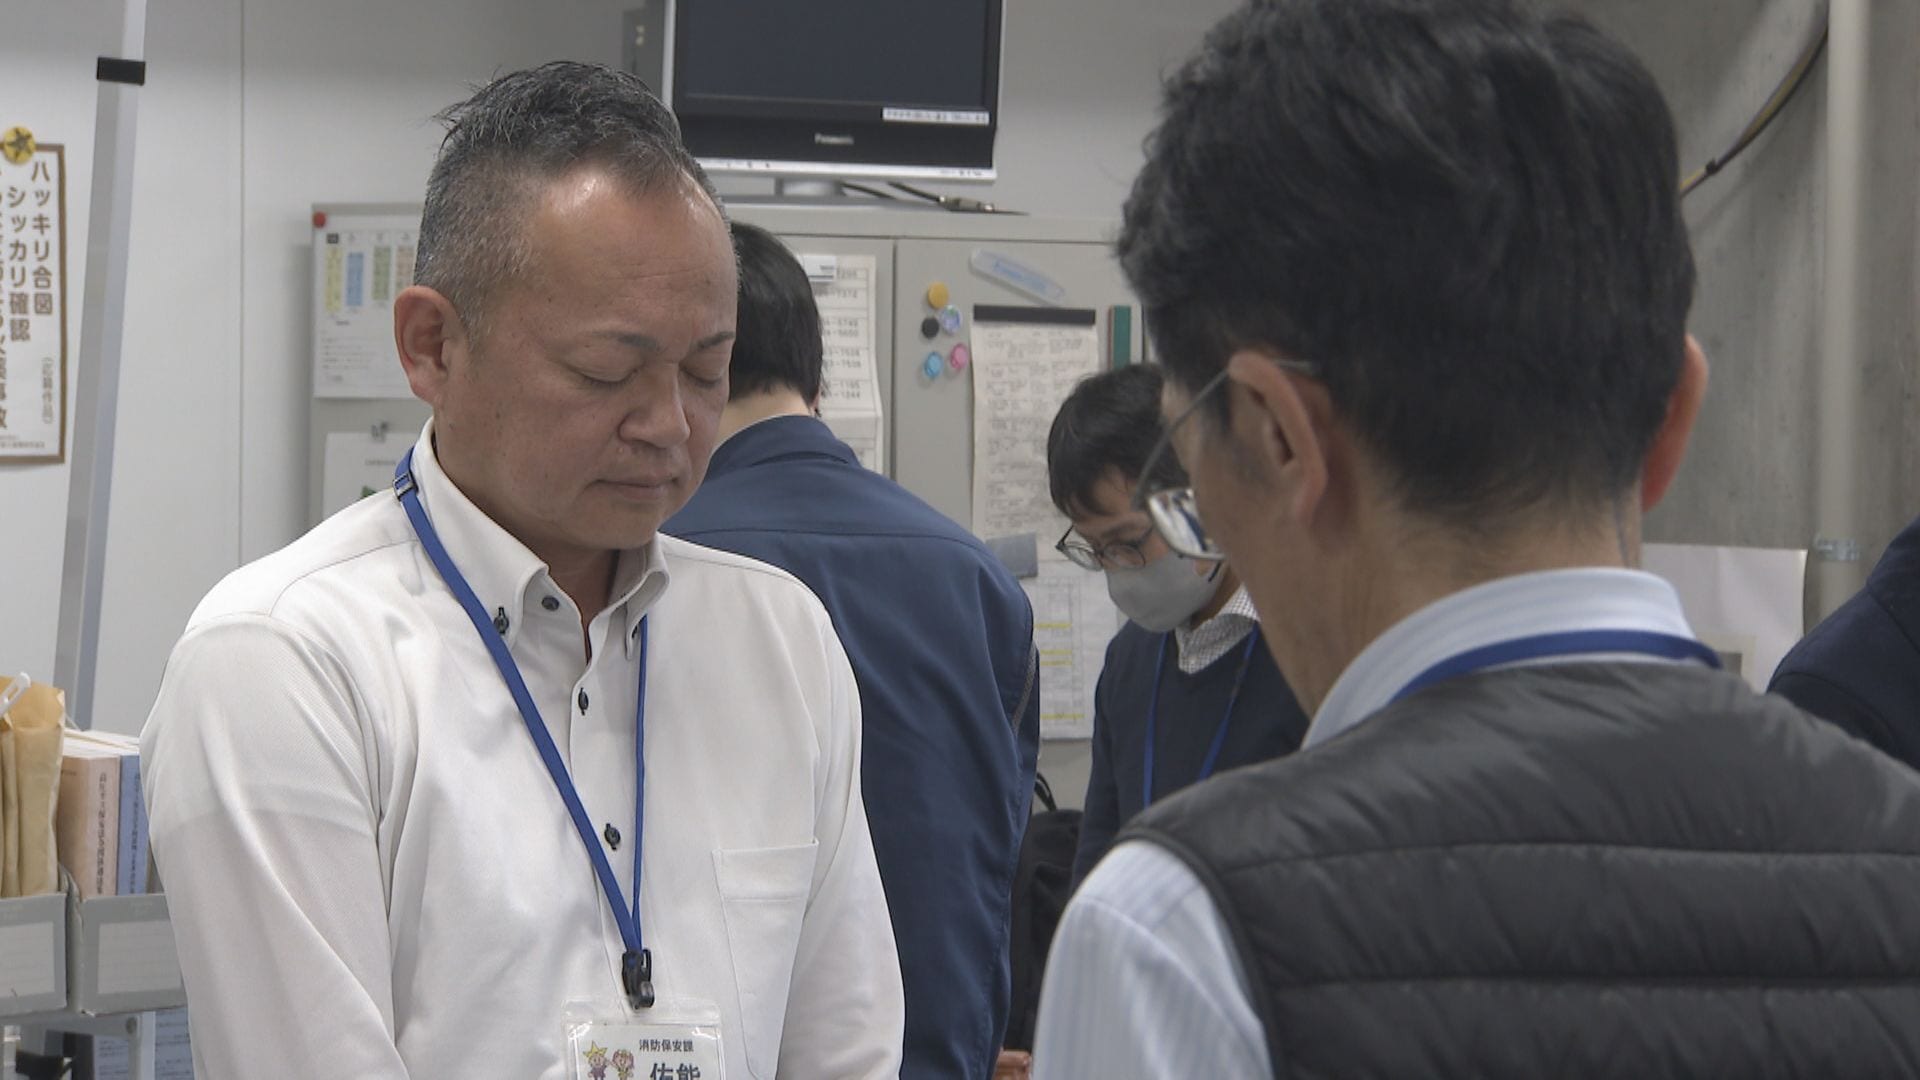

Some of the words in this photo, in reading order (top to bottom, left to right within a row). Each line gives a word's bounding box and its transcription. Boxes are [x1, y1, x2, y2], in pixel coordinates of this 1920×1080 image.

[8, 186, 31, 341] シッカリ確認
[31, 160, 53, 315] ハッキリ合図
[639, 1038, 694, 1052] 消防保安課
[649, 1062, 701, 1080] 佐能
